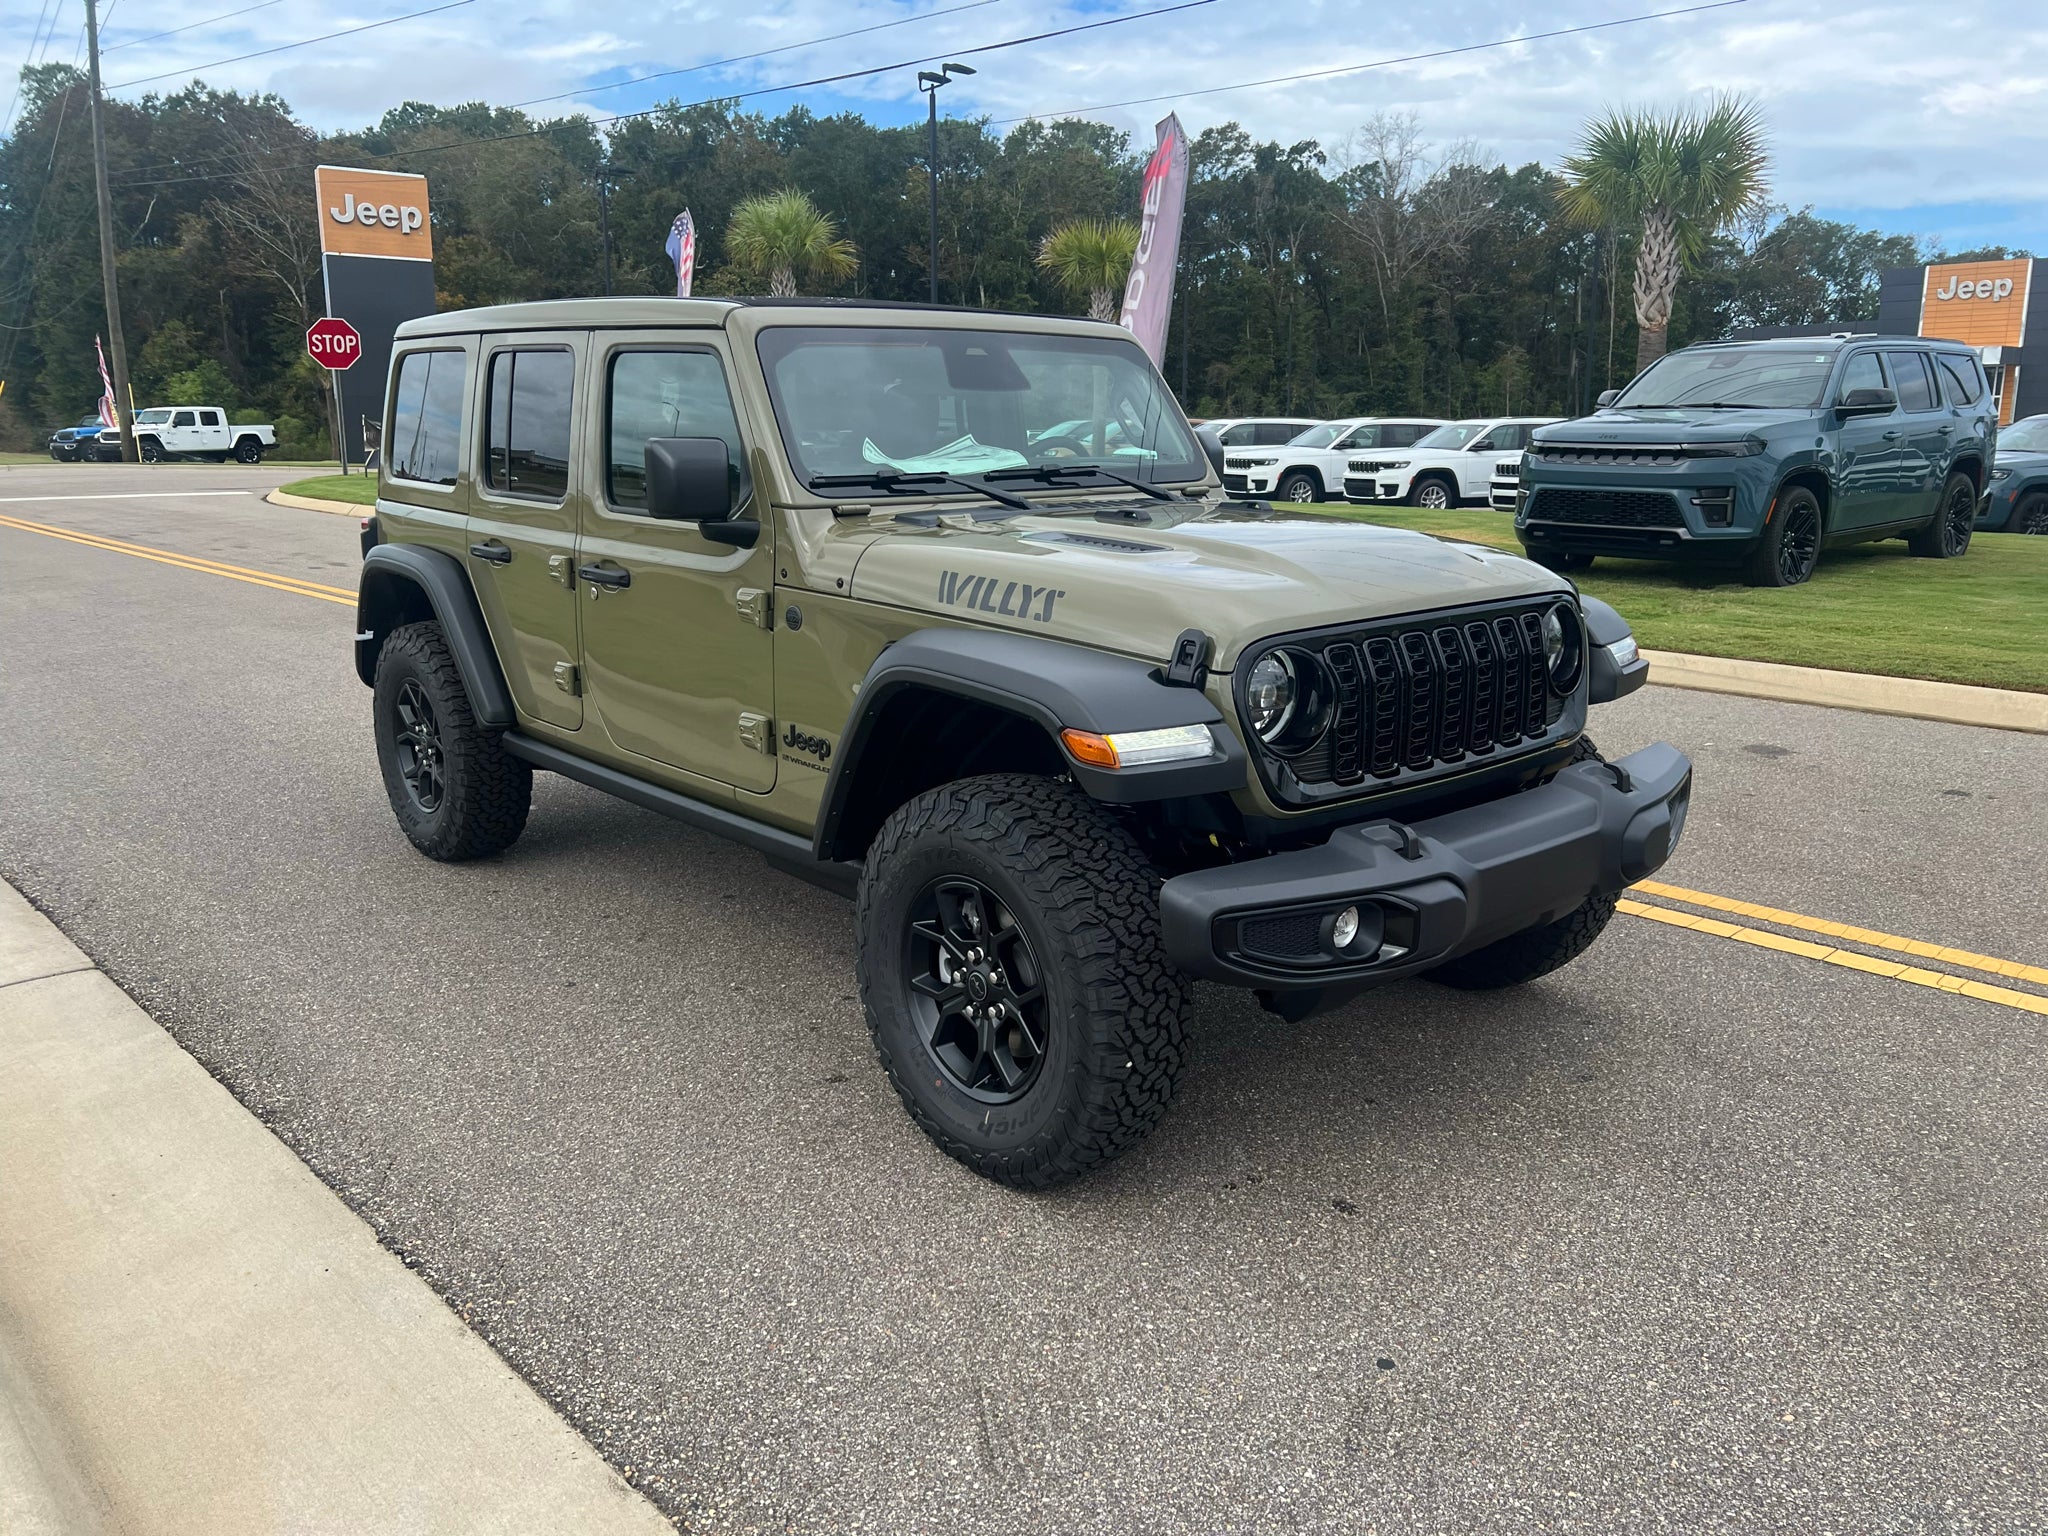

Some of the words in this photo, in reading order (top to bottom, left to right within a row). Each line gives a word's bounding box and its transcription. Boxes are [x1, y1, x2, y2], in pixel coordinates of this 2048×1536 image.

[330, 193, 423, 235] Jeep
[1120, 175, 1163, 333] DGE
[1936, 275, 2014, 303] Jeep
[311, 334, 357, 354] STOP
[938, 570, 1066, 623] WILLYS
[783, 724, 831, 761] Jeep
